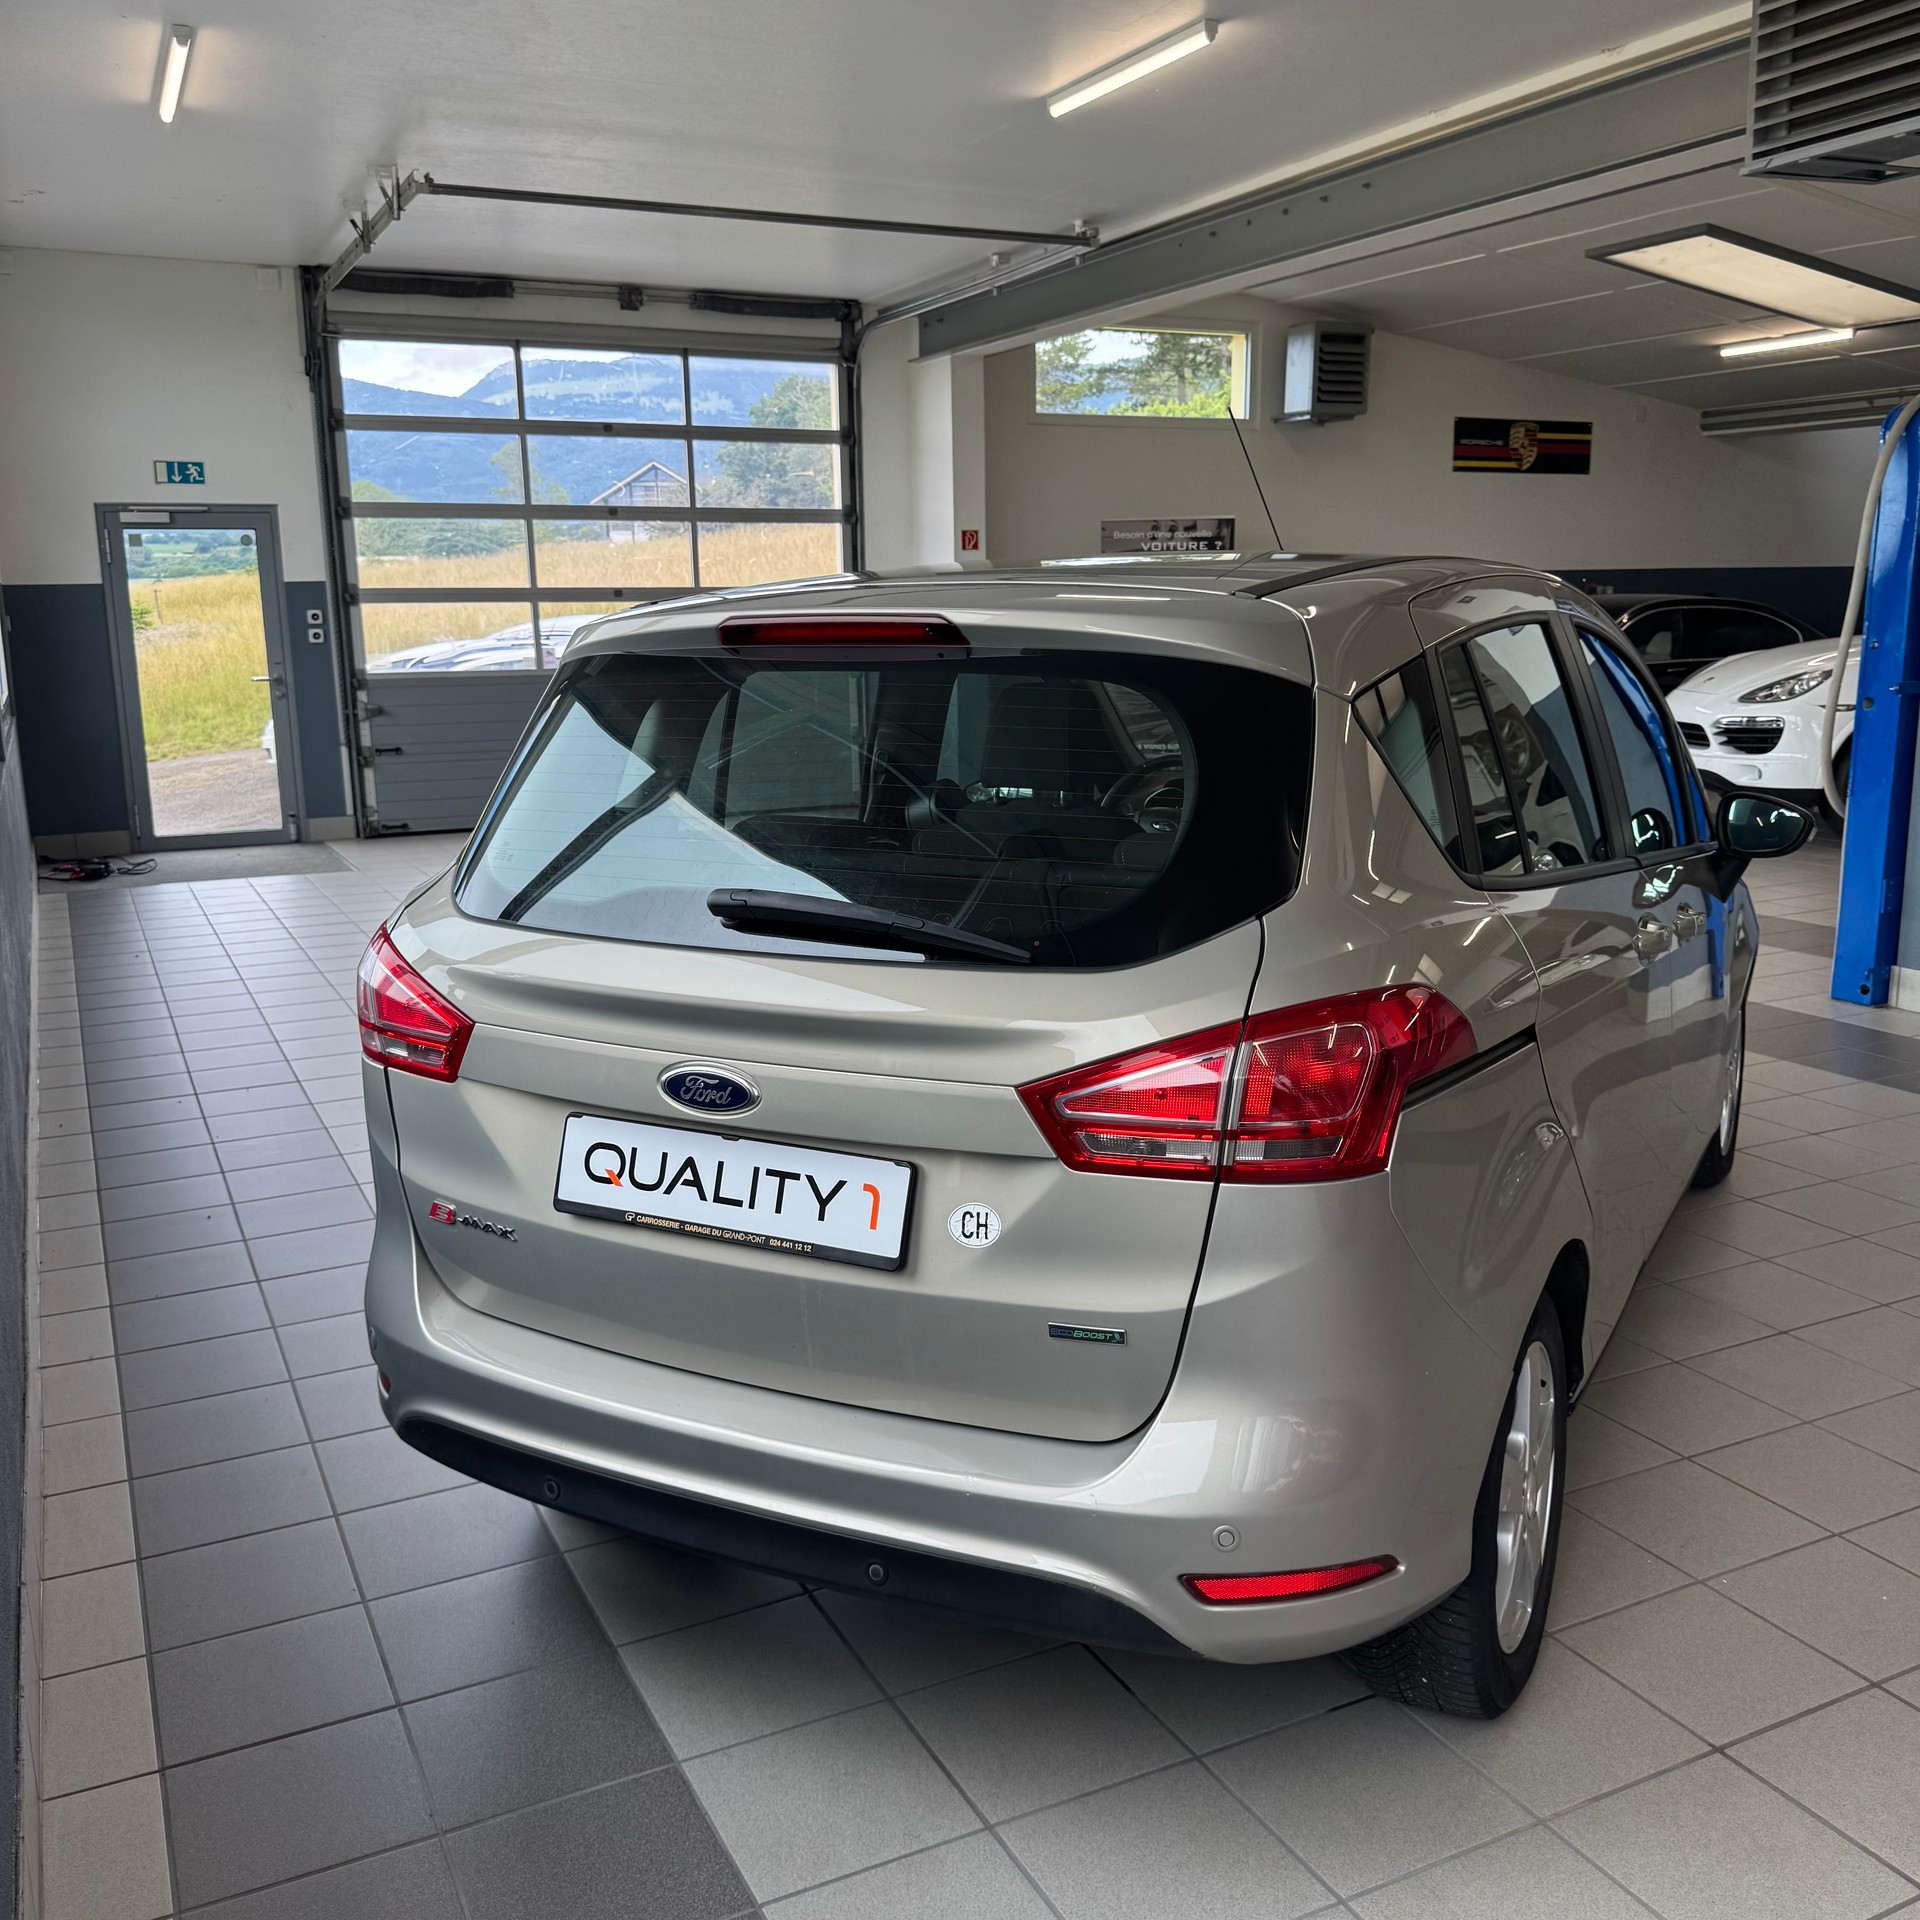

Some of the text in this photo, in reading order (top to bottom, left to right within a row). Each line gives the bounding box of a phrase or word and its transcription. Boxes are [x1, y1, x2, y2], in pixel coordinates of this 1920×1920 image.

[1113, 531, 1144, 539] Besoin
[1141, 541, 1208, 551] VOITURE
[680, 1075, 733, 1104] Ford
[584, 1142, 880, 1230] QUALITY 1
[636, 1215, 680, 1229] CARROSSERIE
[684, 1224, 711, 1235] GARAGE
[712, 1228, 722, 1237] DU
[723, 1230, 766, 1244] GRAND-PONT
[769, 1238, 781, 1248] 024
[782, 1240, 793, 1249] 441
[795, 1243, 803, 1251] 12
[804, 1244, 812, 1252] 12
[961, 1211, 988, 1240] CH
